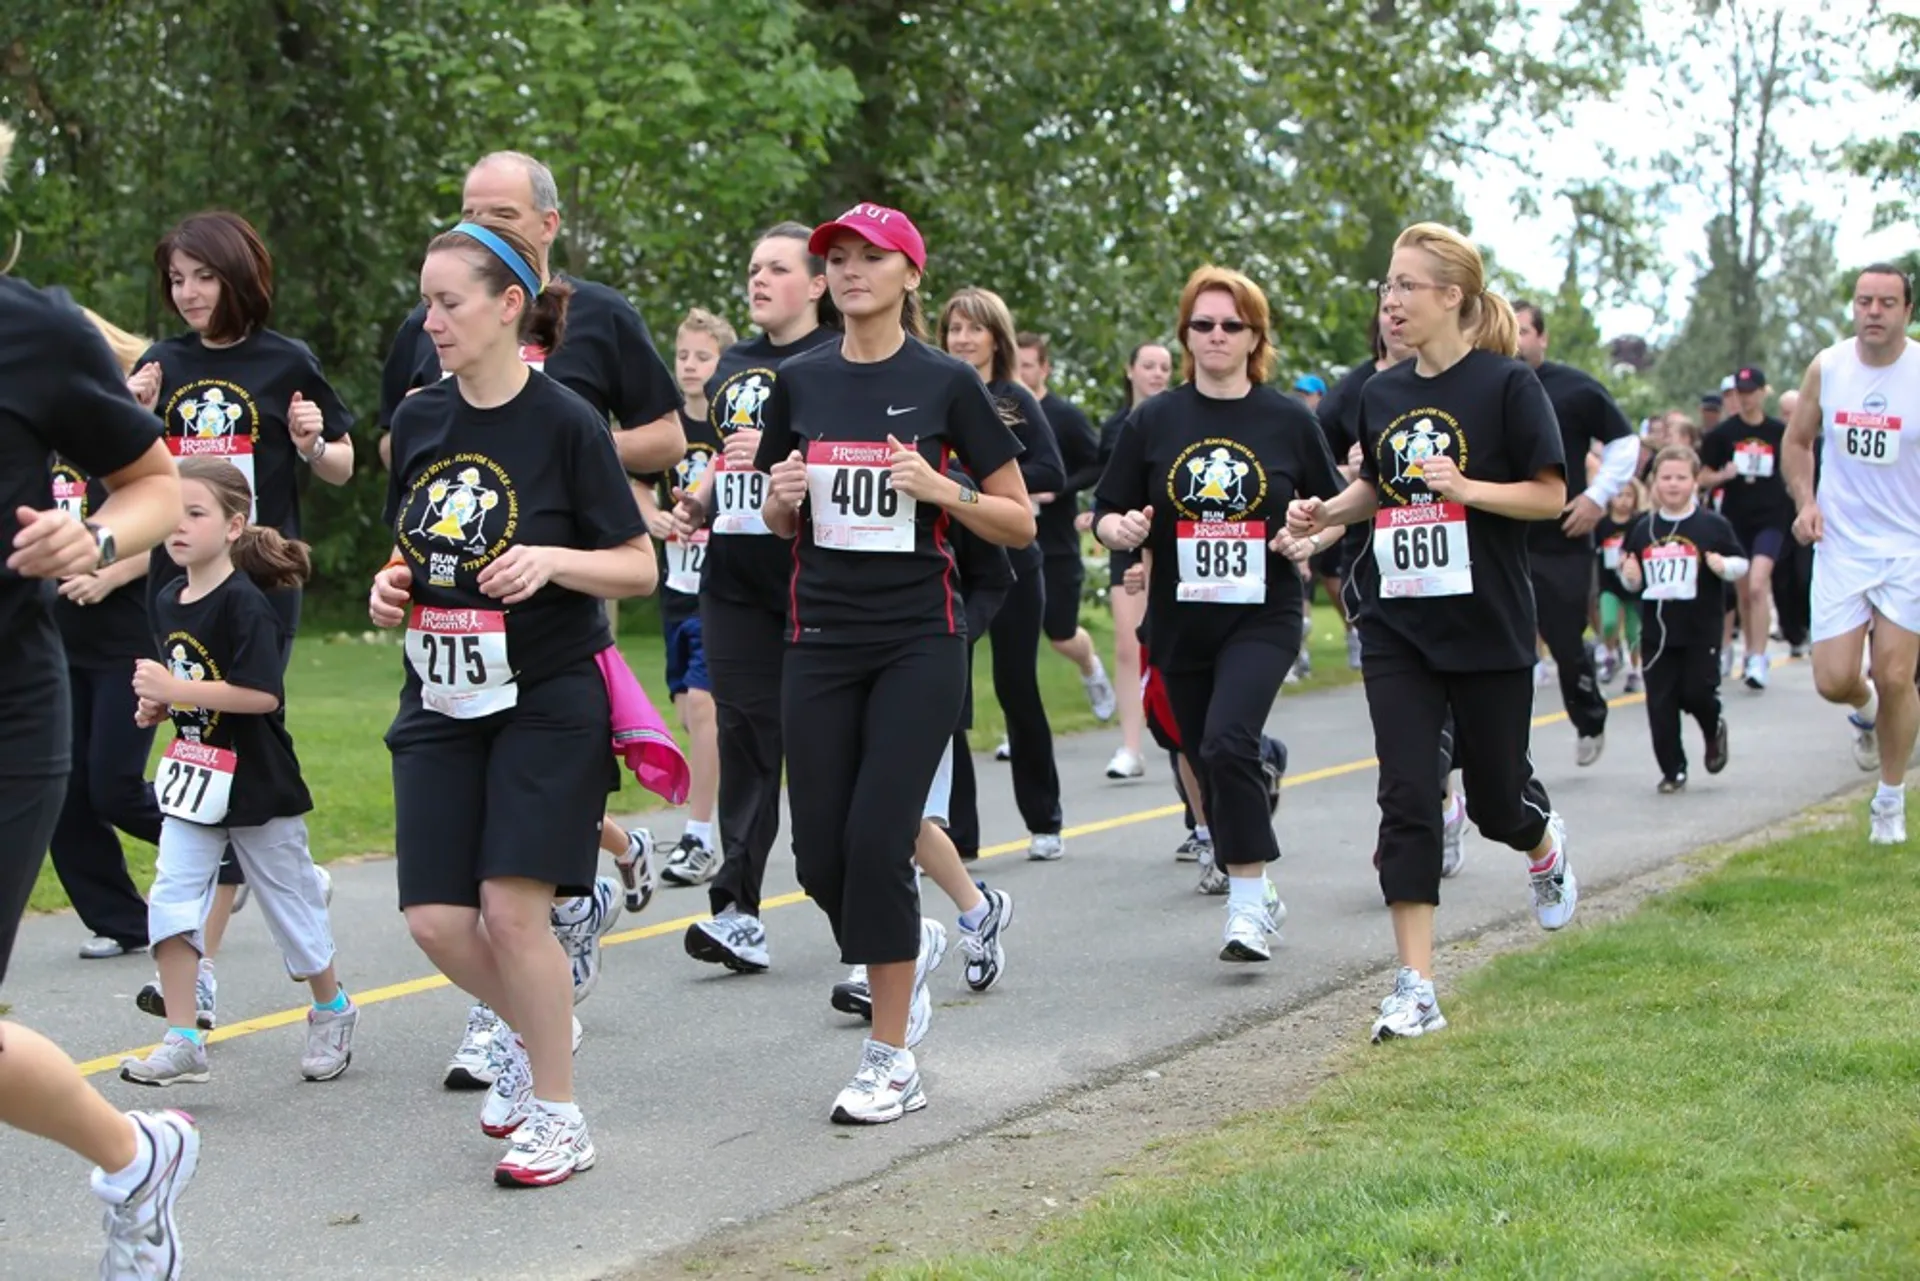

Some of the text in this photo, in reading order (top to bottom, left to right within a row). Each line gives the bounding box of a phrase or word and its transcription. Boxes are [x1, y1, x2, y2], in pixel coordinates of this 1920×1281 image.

[1847, 428, 1887, 458] 636
[724, 473, 763, 510] 619
[831, 468, 898, 518] 406
[430, 552, 459, 565] RUN
[1196, 540, 1247, 577] 983
[1393, 524, 1449, 570] 660
[430, 562, 456, 576] FOR
[1649, 558, 1688, 583] 1277
[422, 633, 487, 685] 275
[161, 760, 213, 813] 277
